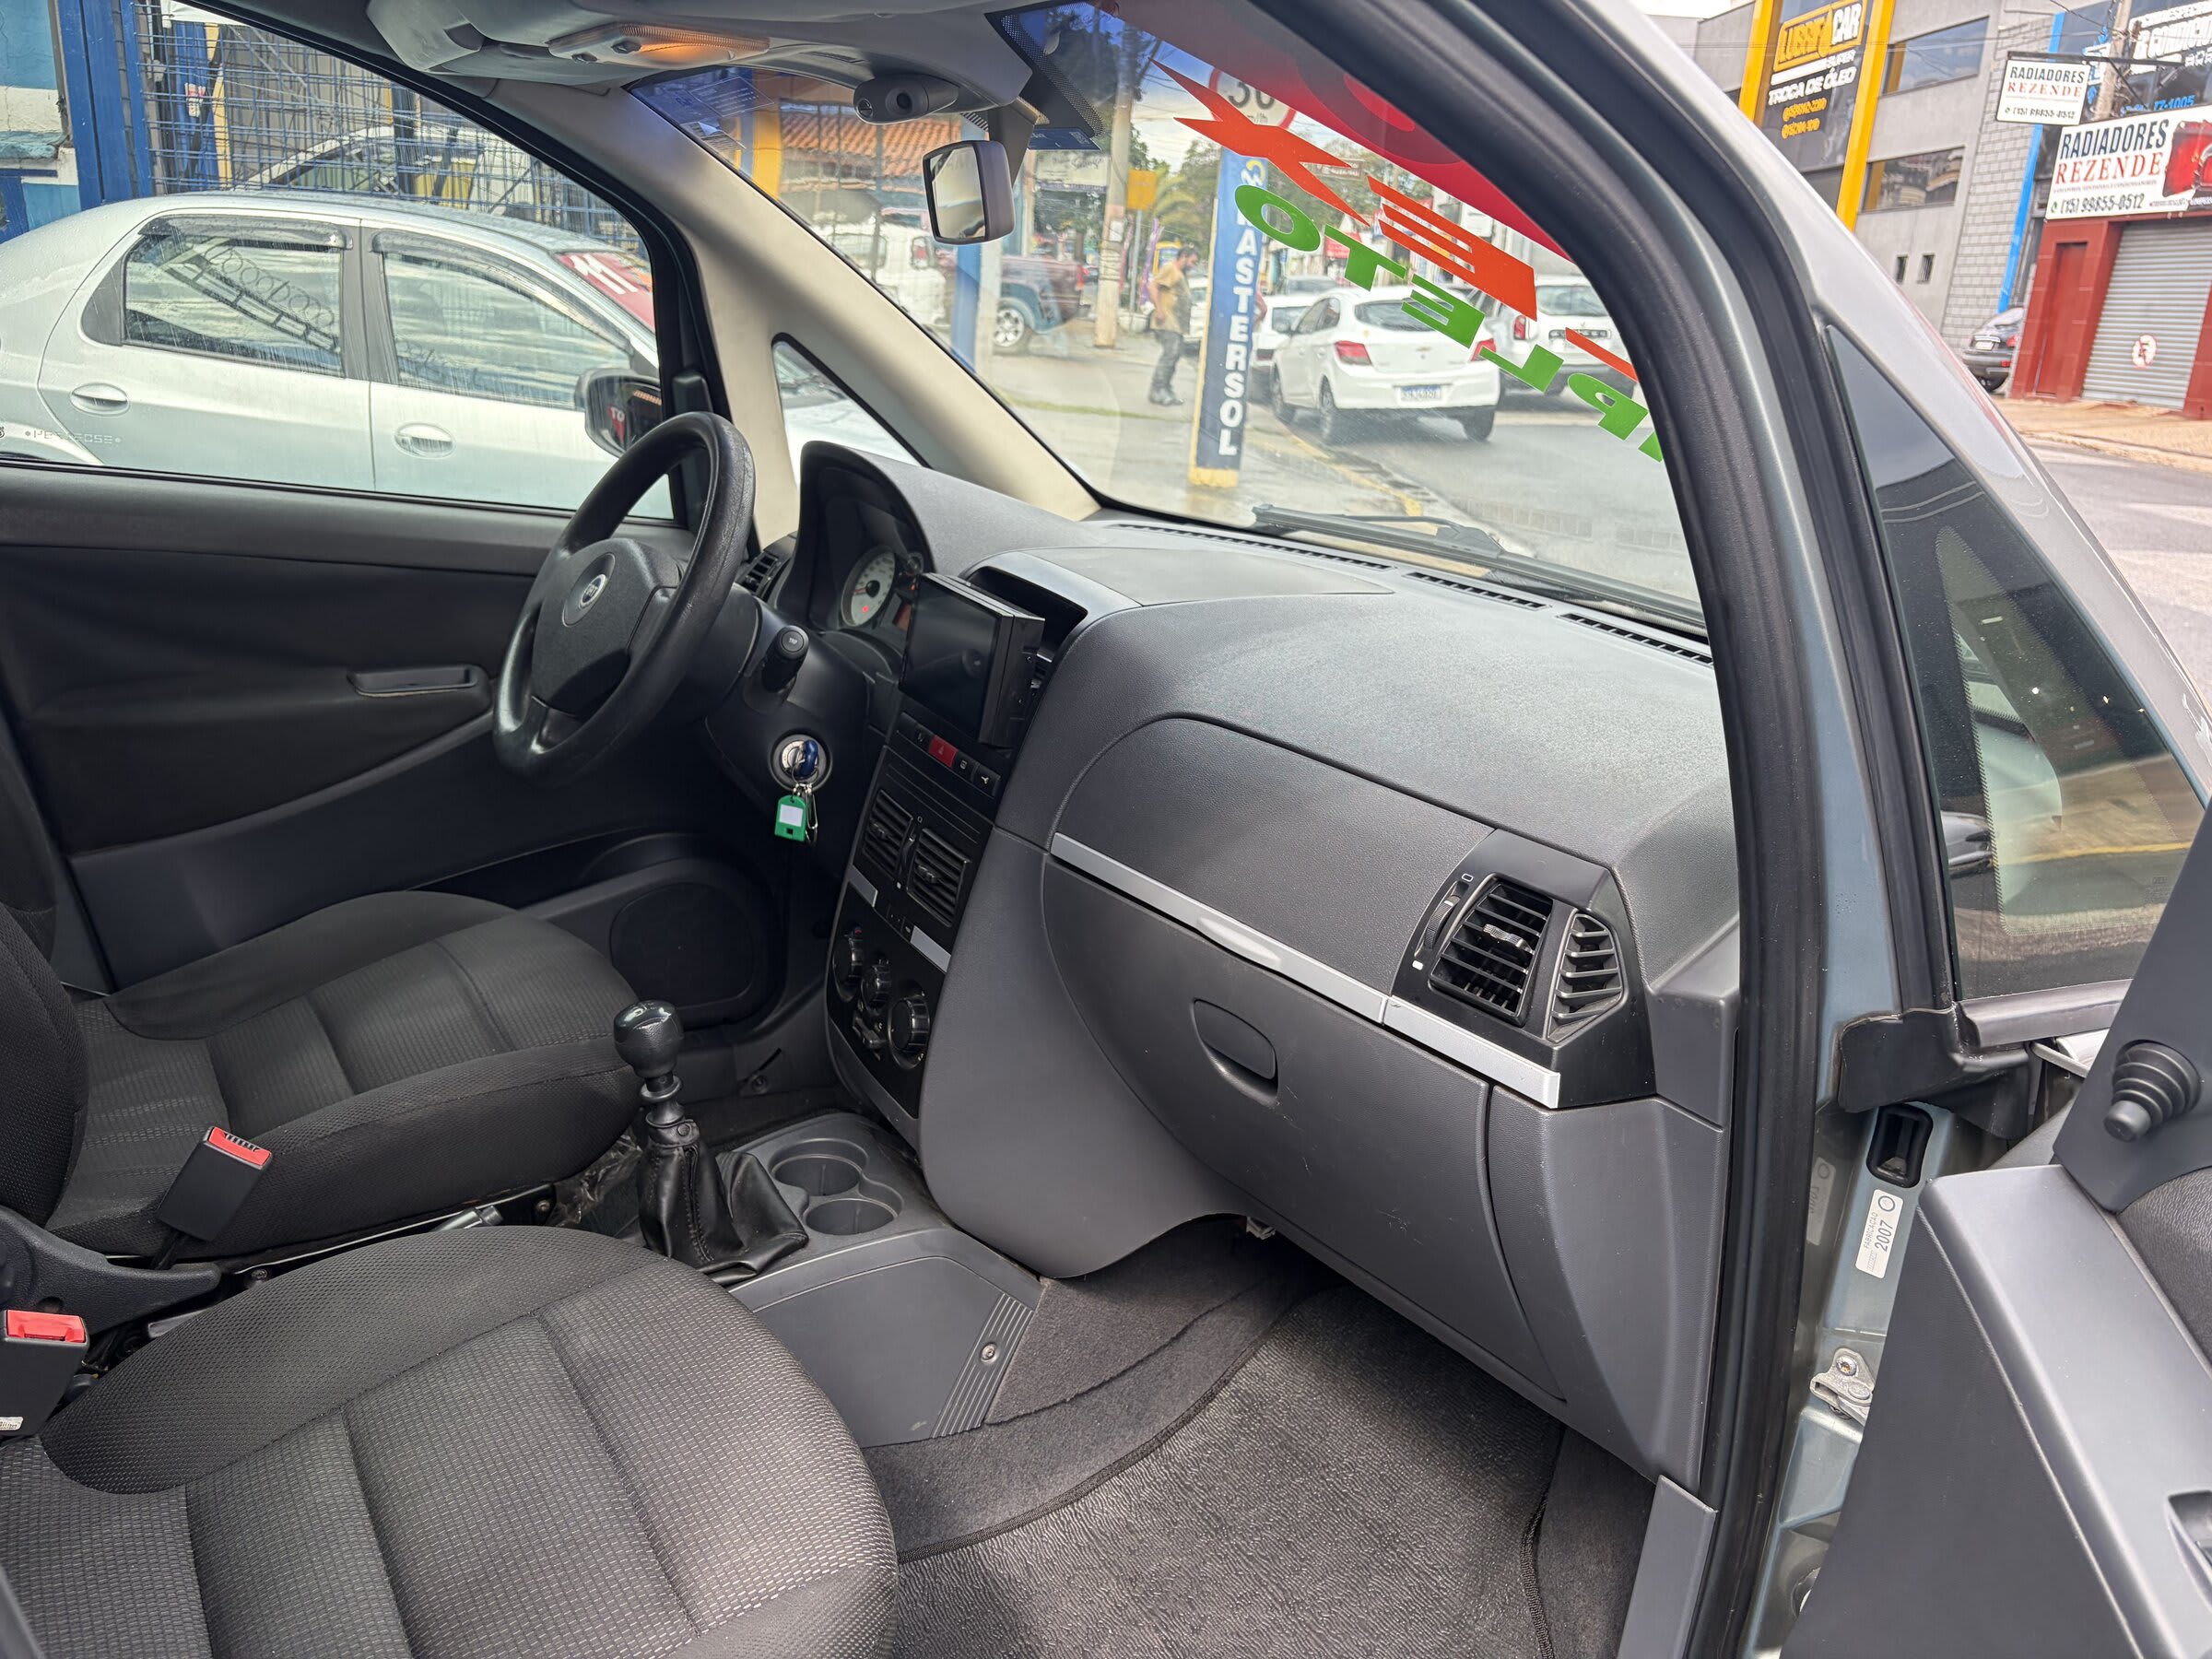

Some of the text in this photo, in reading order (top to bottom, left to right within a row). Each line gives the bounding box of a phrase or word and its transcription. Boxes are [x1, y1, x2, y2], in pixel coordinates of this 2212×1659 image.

[1831, 3, 1862, 45] CAR
[1768, 66, 1857, 106] TROCA DE ÓLEO
[2007, 82, 2083, 98] REZENDE
[2010, 66, 2086, 84] RADIADORES
[2060, 119, 2170, 160] RADIADORES
[2055, 152, 2164, 184] REZENDE
[1874, 1219, 1894, 1253] 2007
